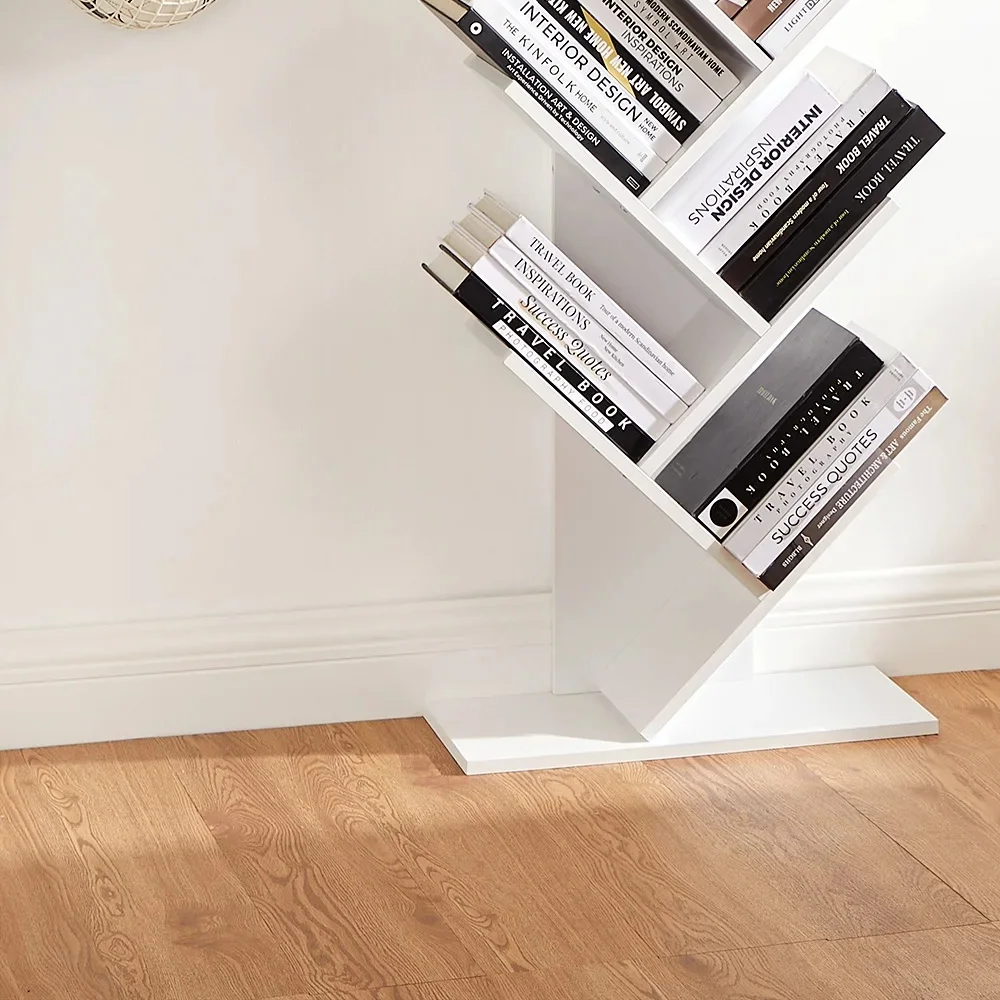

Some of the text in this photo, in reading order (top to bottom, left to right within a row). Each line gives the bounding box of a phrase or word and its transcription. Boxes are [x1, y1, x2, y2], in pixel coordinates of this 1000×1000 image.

[566, 6, 587, 29] NEW
[584, 25, 611, 56] HOME
[633, 0, 693, 61] SYMBOL ART
[668, 19, 708, 60] SCANDINAVIAN
[705, 57, 724, 77] HOME
[784, 7, 808, 31] LIGHT
[501, 18, 596, 112] THE KINFOLK HOME
[520, 1, 641, 122] INTERIOR DESIGN
[614, 55, 632, 76] NEW
[621, 29, 683, 93] INSPIRATIONS
[632, 73, 650, 96] ART
[645, 38, 682, 75] DESIGN
[501, 48, 600, 145] INSTALLATION ART & DESIGN
[505, 63, 584, 141] Art Experience Driven by Technology
[642, 116, 658, 133] NEW
[649, 92, 686, 130] SYMBOL
[637, 122, 656, 142] HOME
[709, 104, 823, 221] INTERIOR DESIGN
[834, 115, 891, 173] TRAVEL BOOK
[685, 133, 776, 224] INSPIRATIONS
[747, 107, 866, 230] TRAVEL BOOK
[755, 185, 779, 209] FOOD
[854, 135, 920, 203] TRAVEL BOOK
[750, 180, 829, 263] Tour modern Scandinavian home
[514, 257, 590, 331] INSPIRATIONS
[528, 237, 595, 301] TRAVEL BOOK
[490, 297, 631, 430] TRAVEL BOOK
[519, 292, 613, 384] Success Quotes
[598, 303, 676, 377] Tour modern Scandinavian home
[498, 324, 605, 425] PHOTOGRAPHY FOOD
[744, 369, 864, 494] TRAVEL BOOK
[898, 416, 921, 439] Famous
[918, 404, 932, 418] The
[752, 397, 871, 524] TRAVEL BOOK
[773, 430, 854, 513] PHOTOGRAPHY
[882, 437, 900, 456] ART
[769, 428, 880, 544] SUCCESS QUOTES
[833, 457, 884, 508] ARCHITECTURE
[816, 507, 837, 529] Designer
